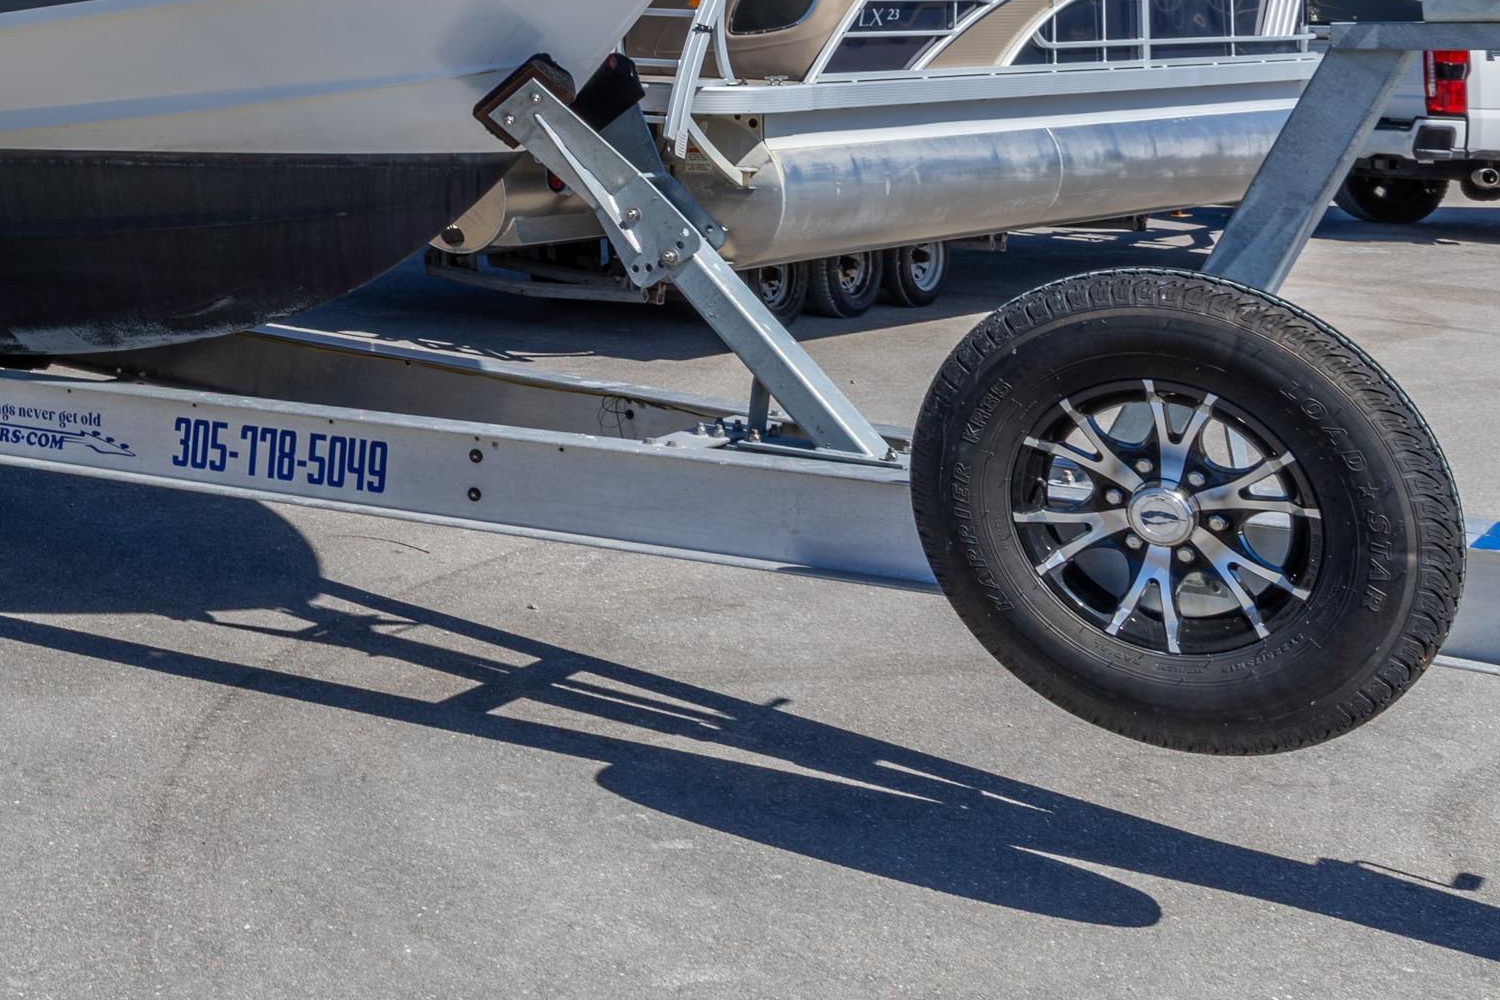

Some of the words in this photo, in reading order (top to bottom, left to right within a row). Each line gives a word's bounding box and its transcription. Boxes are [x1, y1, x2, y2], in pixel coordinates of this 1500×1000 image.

[887, 8, 900, 20] 23
[18, 406, 56, 421] never
[58, 410, 79, 428] get
[80, 411, 101, 427] old
[172, 416, 388, 494] 305-778-5049
[1362, 509, 1393, 613] STAR
